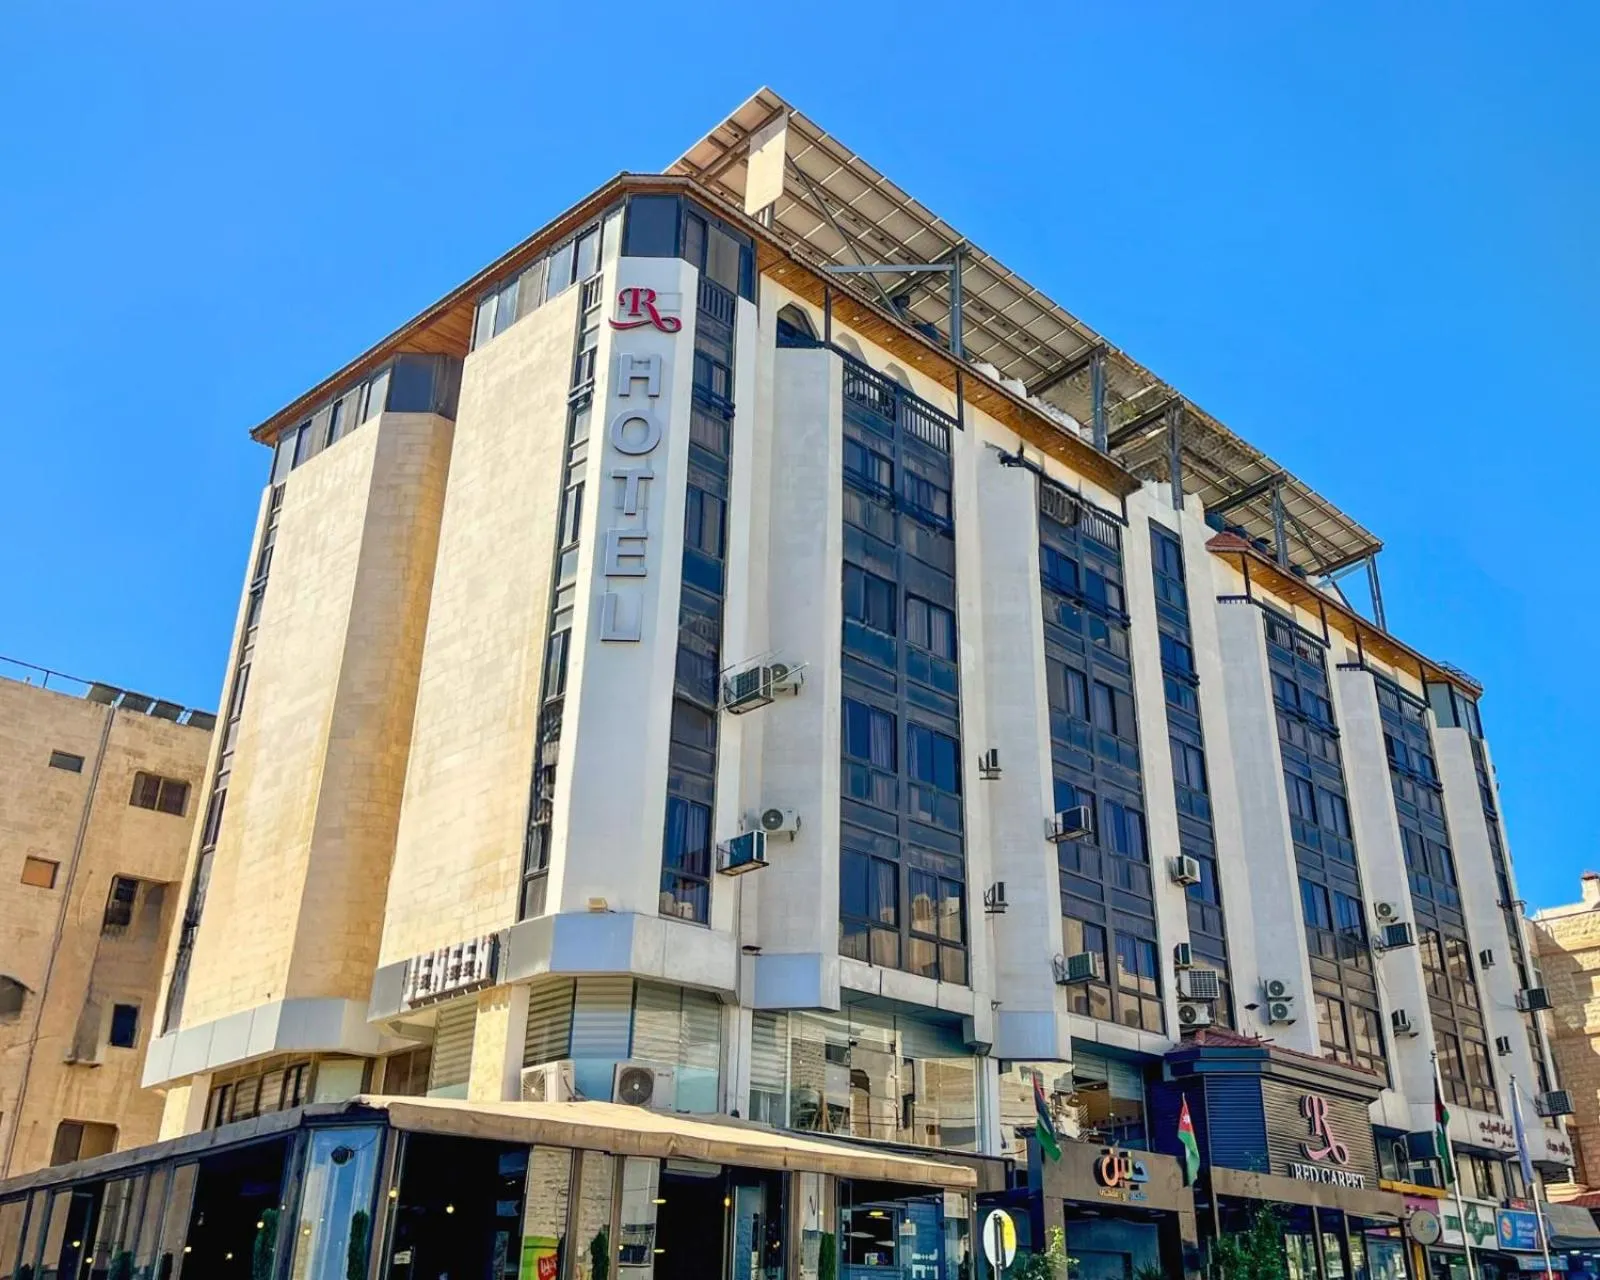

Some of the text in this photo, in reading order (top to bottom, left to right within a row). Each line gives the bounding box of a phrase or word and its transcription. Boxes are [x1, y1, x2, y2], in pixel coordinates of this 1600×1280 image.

[600, 352, 662, 642] HOTEL
[1294, 1162, 1365, 1190] RED CARPET
